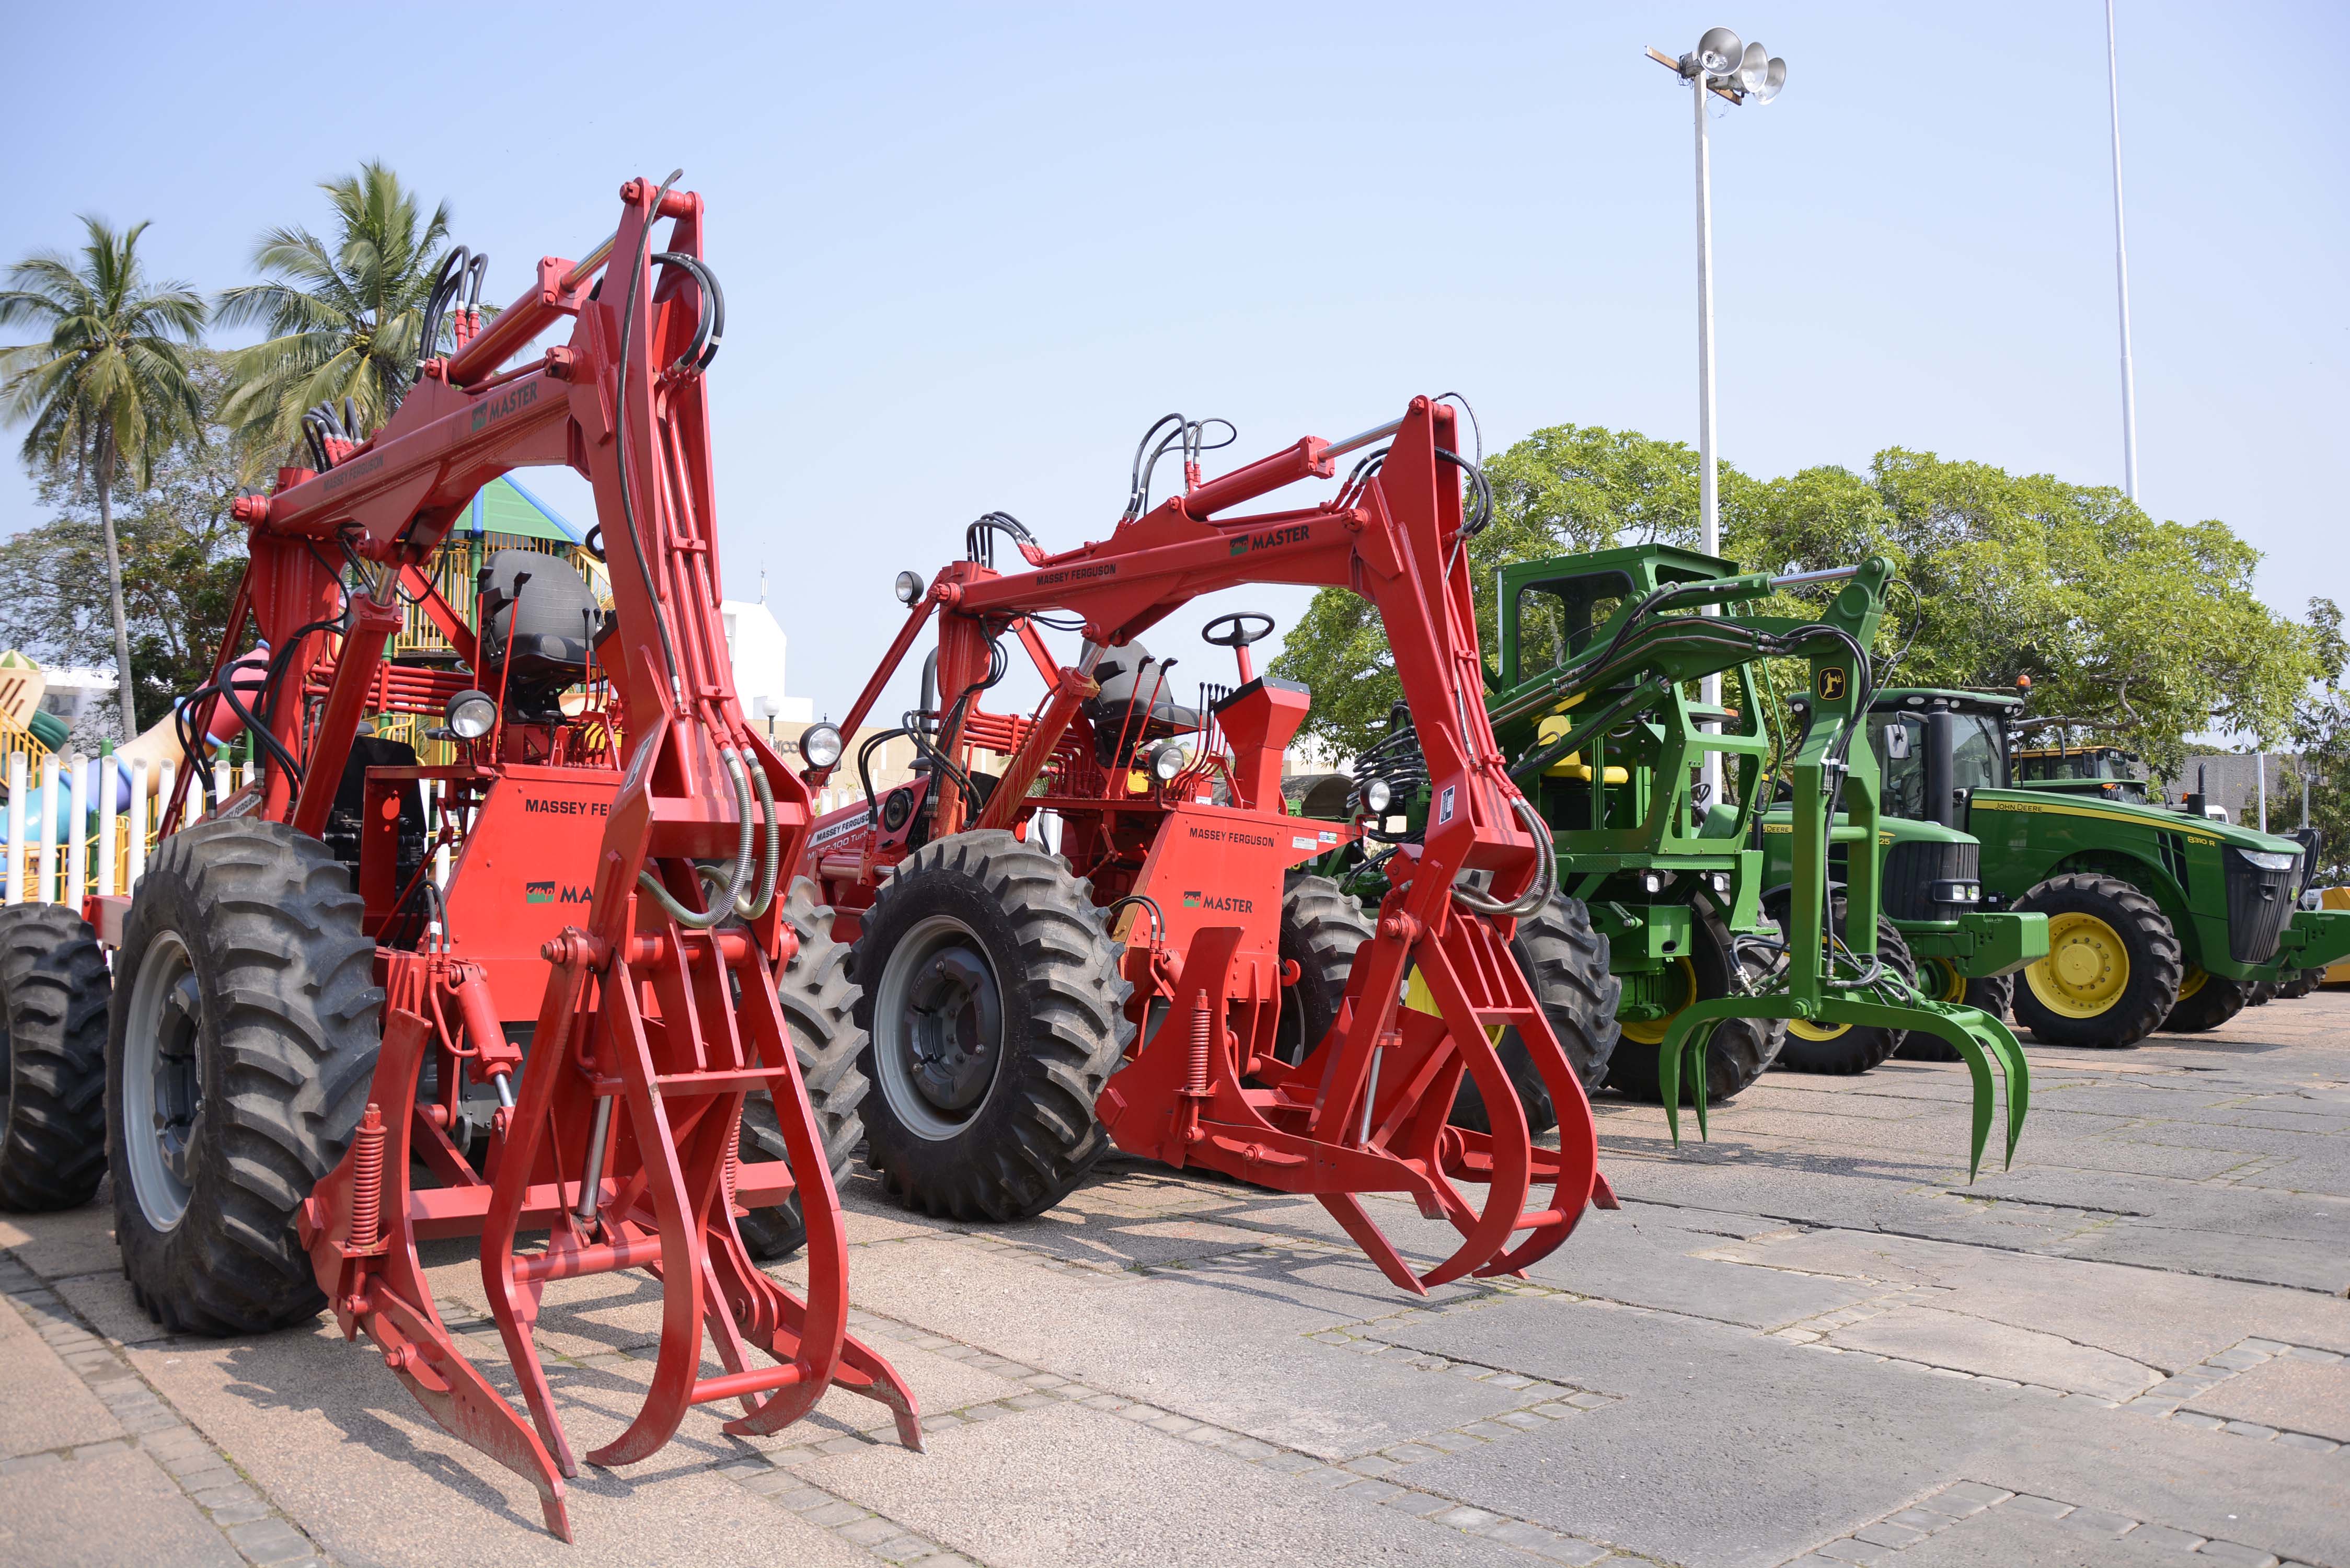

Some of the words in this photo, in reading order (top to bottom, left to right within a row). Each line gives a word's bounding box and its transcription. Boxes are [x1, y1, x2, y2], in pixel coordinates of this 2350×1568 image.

[489, 382, 538, 423] MASTER
[323, 469, 348, 492] MASSEY
[349, 453, 384, 481] FERGUSON
[1251, 525, 1310, 551] MASTER
[1036, 571, 1069, 586] MASSEY
[1071, 563, 1116, 581] FERGUSON
[525, 799, 588, 815] MASSEY
[591, 802, 612, 816] FE
[1994, 802, 2015, 811] JOHN
[2017, 803, 2043, 812] DEERE
[816, 825, 841, 842] MASSEY
[842, 813, 869, 832] FERGUSO
[1190, 827, 1227, 841] MASSEY
[1228, 832, 1274, 847] FERGUSON
[2187, 836, 2208, 845] 8310
[1203, 895, 1253, 914] MASTER
